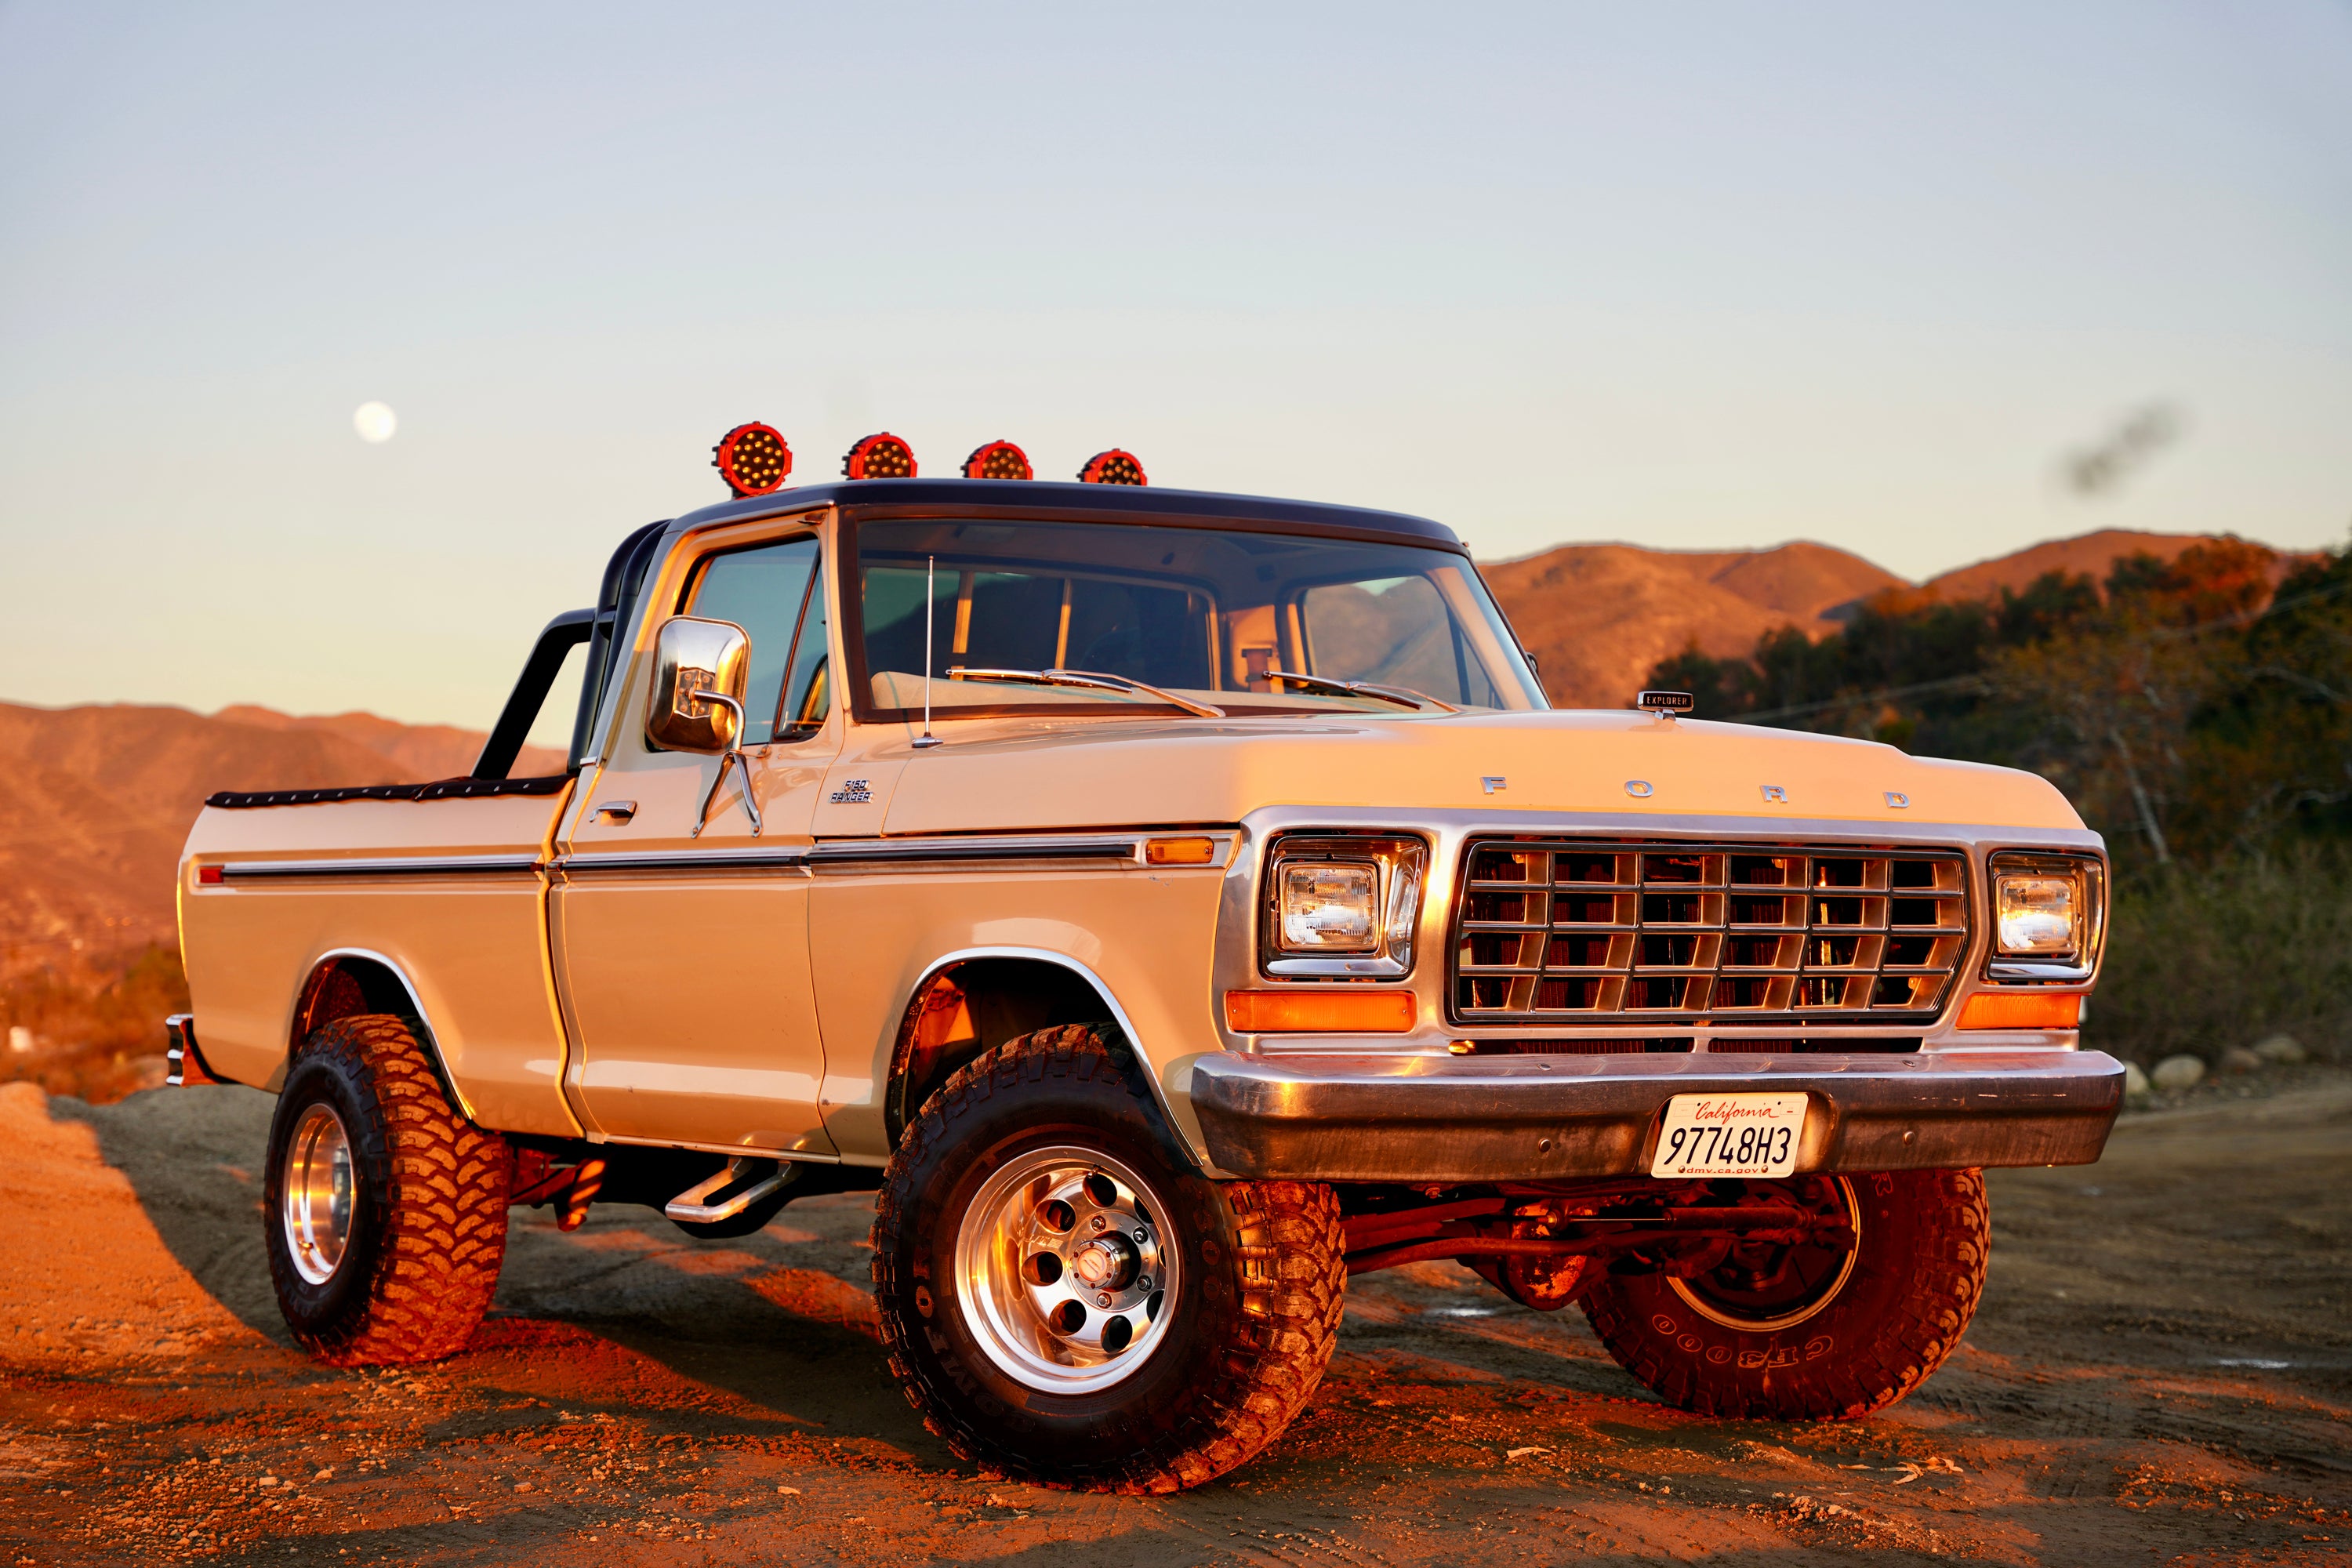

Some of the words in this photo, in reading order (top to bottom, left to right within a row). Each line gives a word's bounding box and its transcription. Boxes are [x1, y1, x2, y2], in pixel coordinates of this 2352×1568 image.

[1646, 695, 1687, 706] EXPLORER
[829, 792, 872, 804] RANGER
[1479, 775, 1911, 809] FORD
[1695, 1101, 1780, 1125] California
[1663, 1127, 1791, 1165] 97748H3
[1686, 1166, 1759, 1174] dmv.ca.gov
[1652, 1313, 1833, 1370] CF3000
